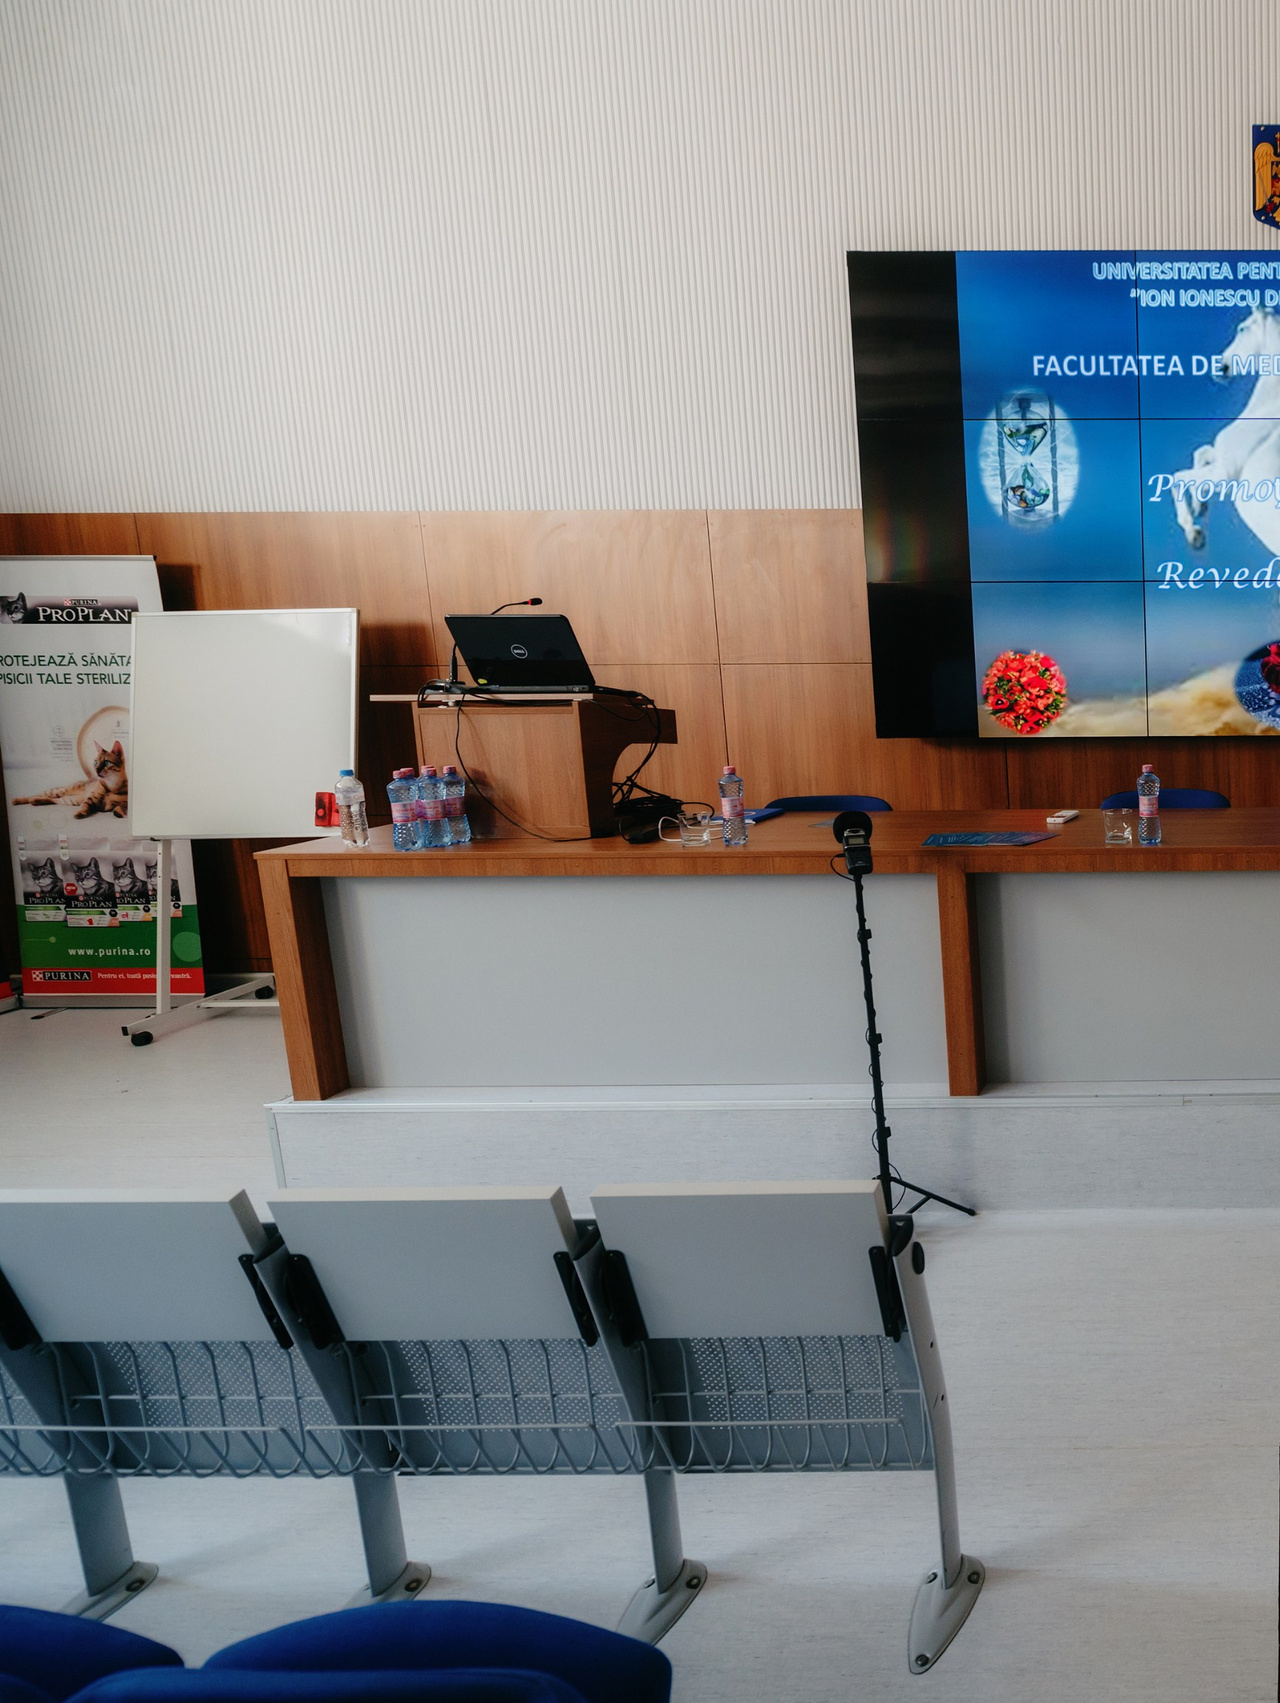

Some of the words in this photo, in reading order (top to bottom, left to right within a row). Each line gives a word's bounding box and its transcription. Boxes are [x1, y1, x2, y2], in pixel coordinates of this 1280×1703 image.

[1092, 261, 1234, 280] UNIVERSITATEA
[1179, 288, 1261, 307] IONESCU
[1032, 355, 1185, 376] FACULTATEA
[1191, 355, 1223, 376] DE
[36, 673, 73, 684] TALE
[76, 673, 131, 684] STERILIZ
[67, 946, 151, 957] www.purina.ro
[44, 972, 90, 981] PURINA
